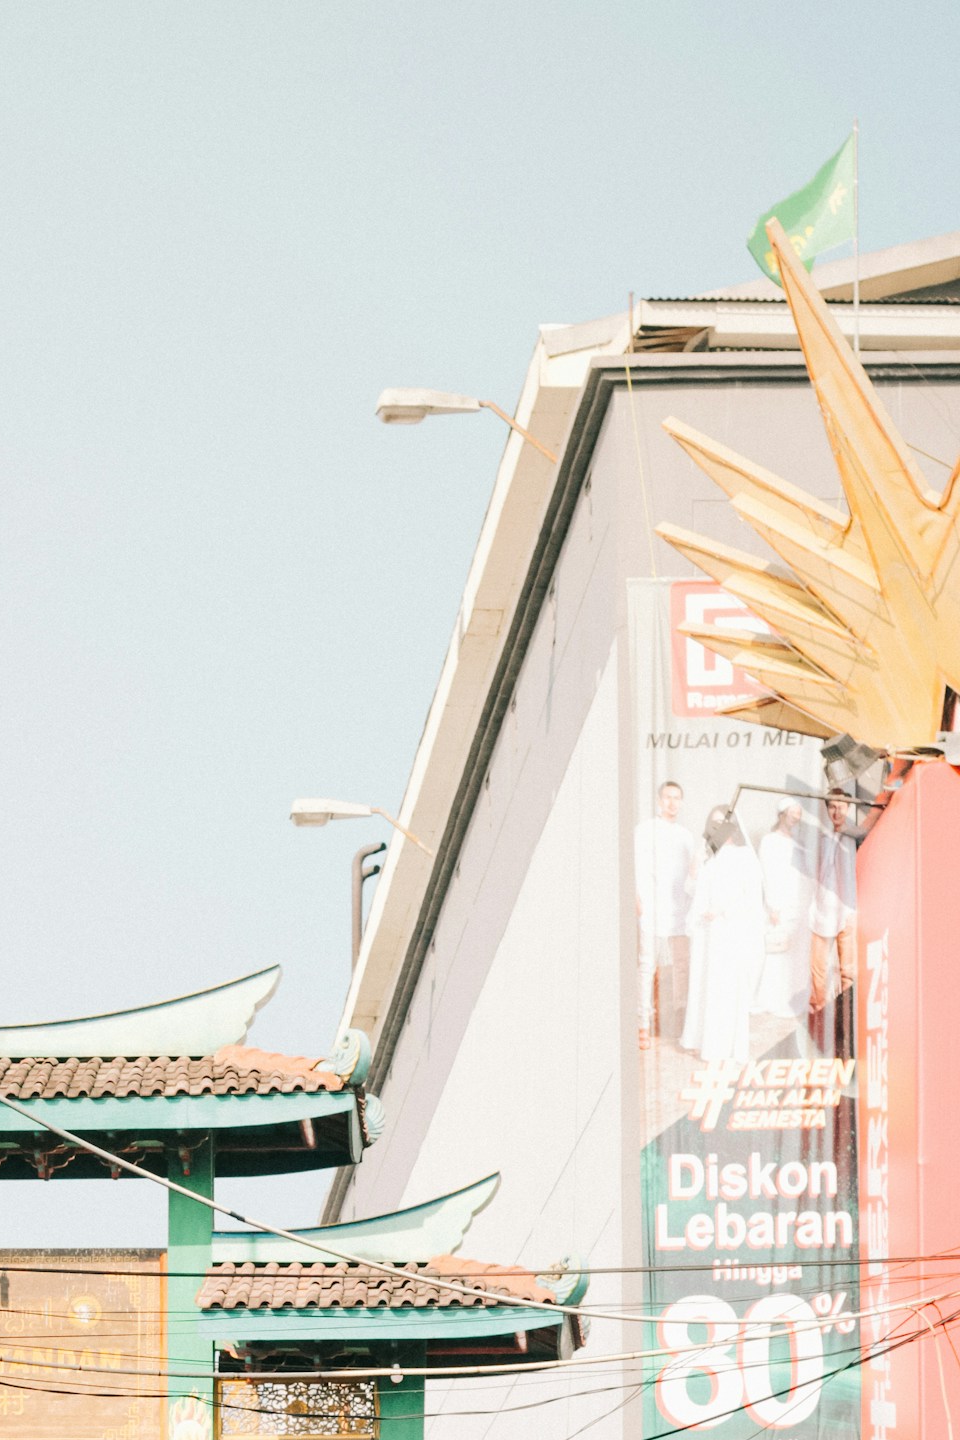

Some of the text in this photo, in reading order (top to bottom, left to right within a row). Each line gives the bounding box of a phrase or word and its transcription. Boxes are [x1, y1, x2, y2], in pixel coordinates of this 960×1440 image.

[646, 732, 719, 749] MULAI
[726, 731, 752, 748] 01
[733, 1088, 842, 1107] HAK ALAM
[728, 1108, 827, 1130] SEMESTA
[668, 1152, 838, 1200] Diskon
[655, 1203, 854, 1250] Lebaran
[712, 1259, 803, 1284] Hingga
